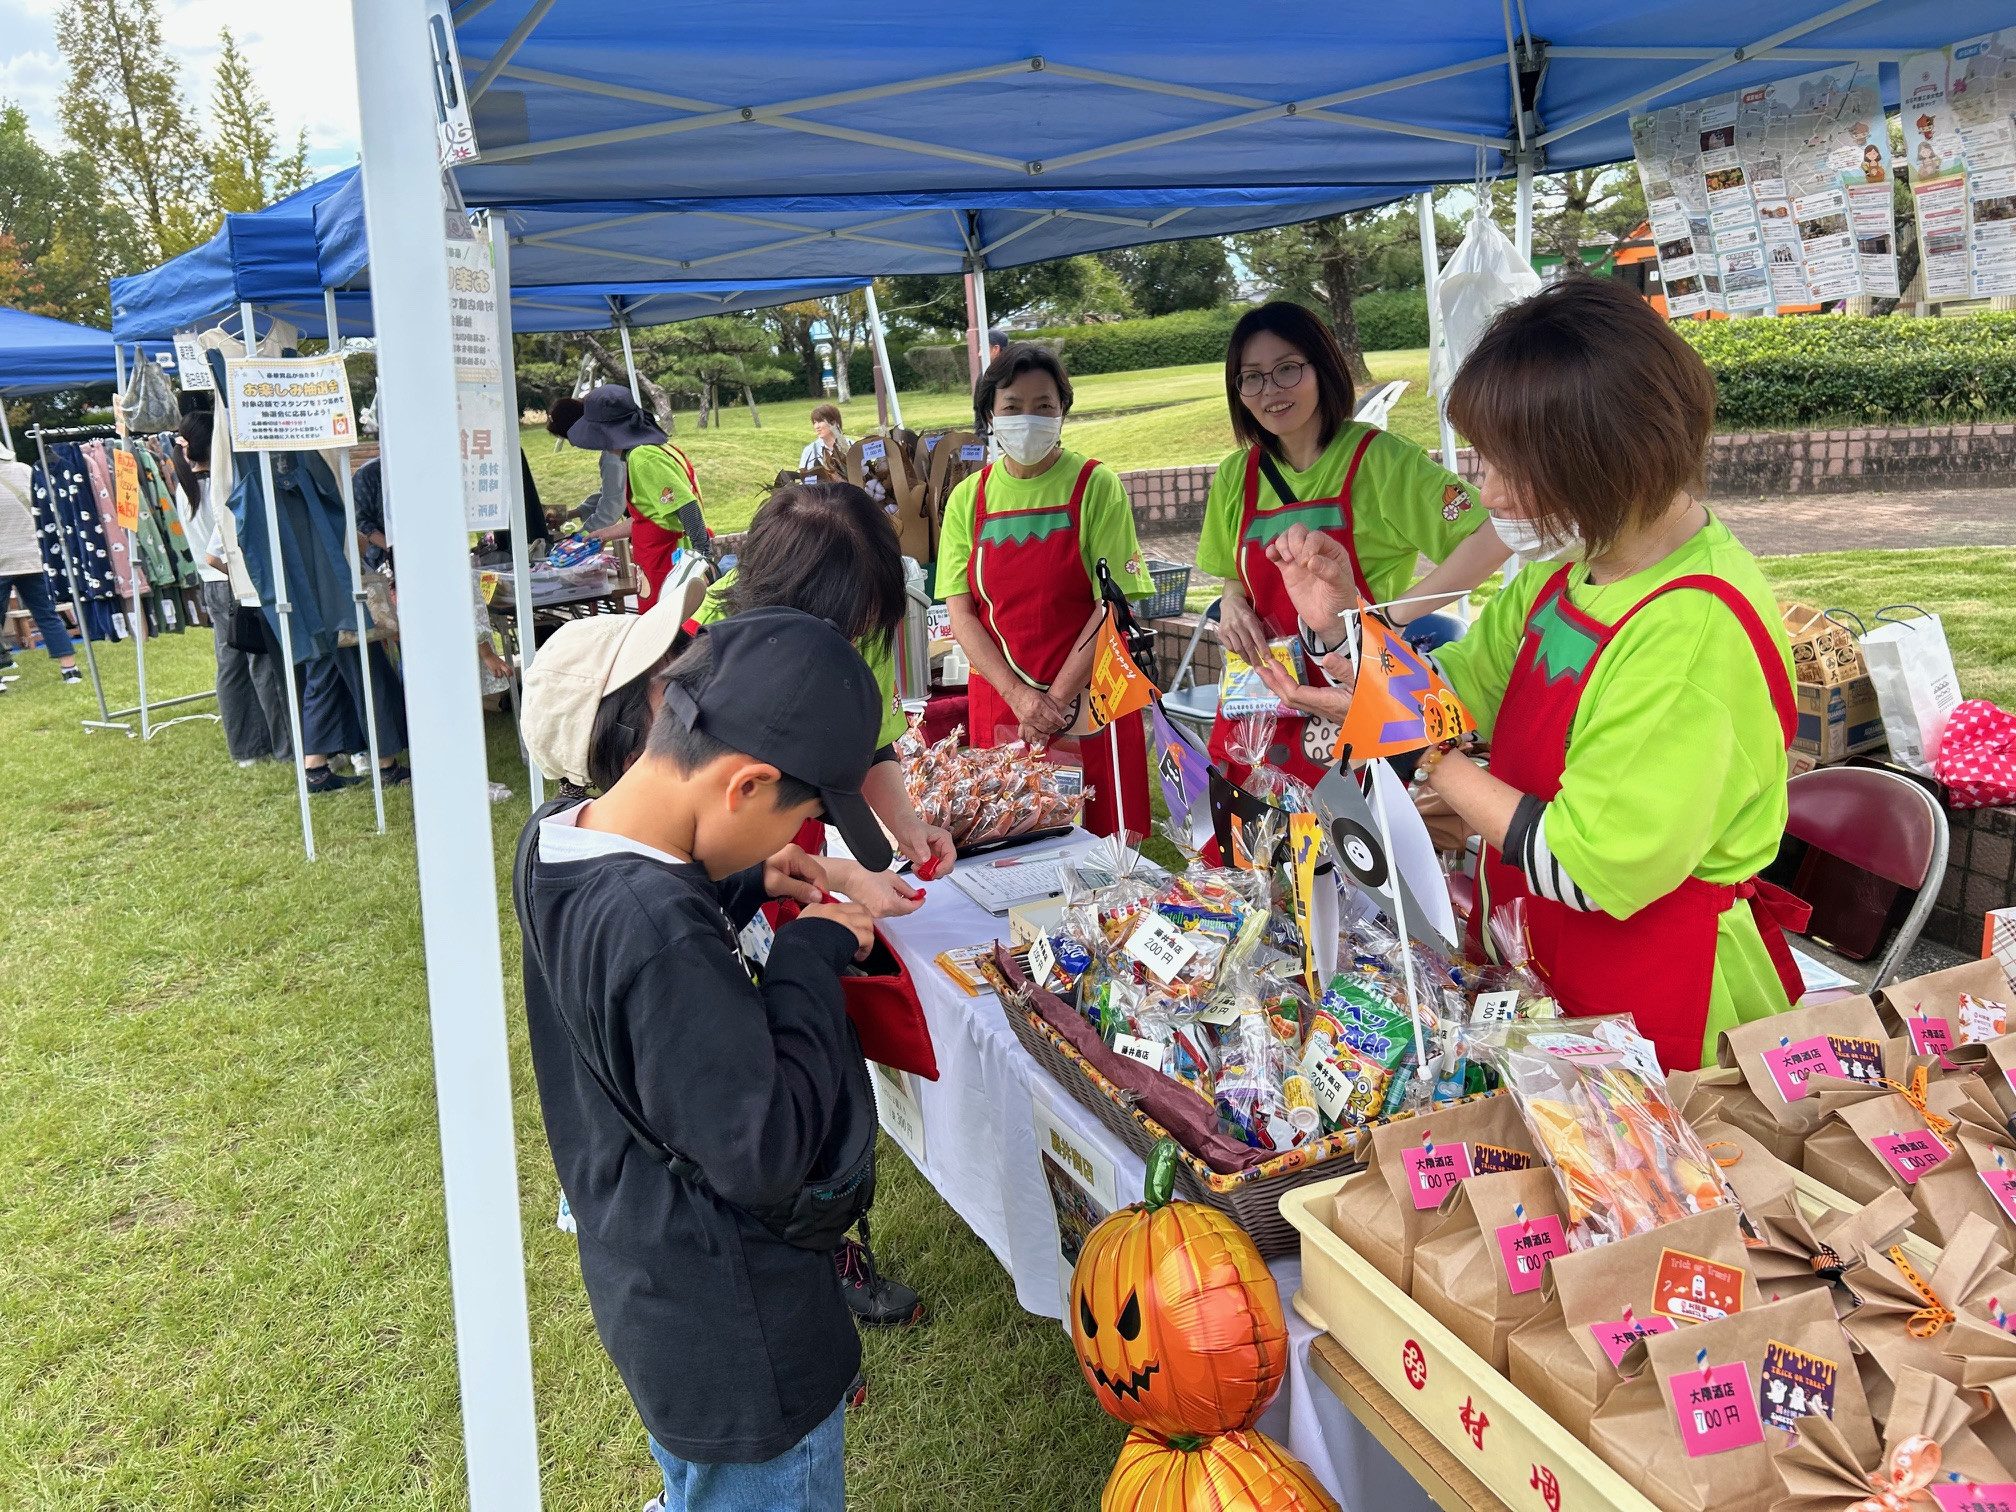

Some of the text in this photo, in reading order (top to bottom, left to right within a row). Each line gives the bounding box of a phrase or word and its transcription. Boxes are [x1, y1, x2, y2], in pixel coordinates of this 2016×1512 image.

[243, 379, 339, 397] お楽しみ抽選会
[1108, 634, 1137, 680] Happy
[1143, 937, 1174, 965] 200円
[1153, 927, 1184, 955] 藤井商店
[1321, 989, 1388, 1030] キャベツ
[1121, 1045, 1150, 1061] 藤井商店
[1338, 1024, 1392, 1061] 太郎
[1310, 1071, 1336, 1102] 200円
[1314, 1060, 1343, 1093] 藤井商店
[1049, 1128, 1095, 1187] 藤井商店
[1670, 1258, 1691, 1270] Trick
[1693, 1264, 1705, 1273] or
[1771, 1365, 1827, 1391] TRICK OR TREAT
[1694, 1404, 1741, 1432] 700円
